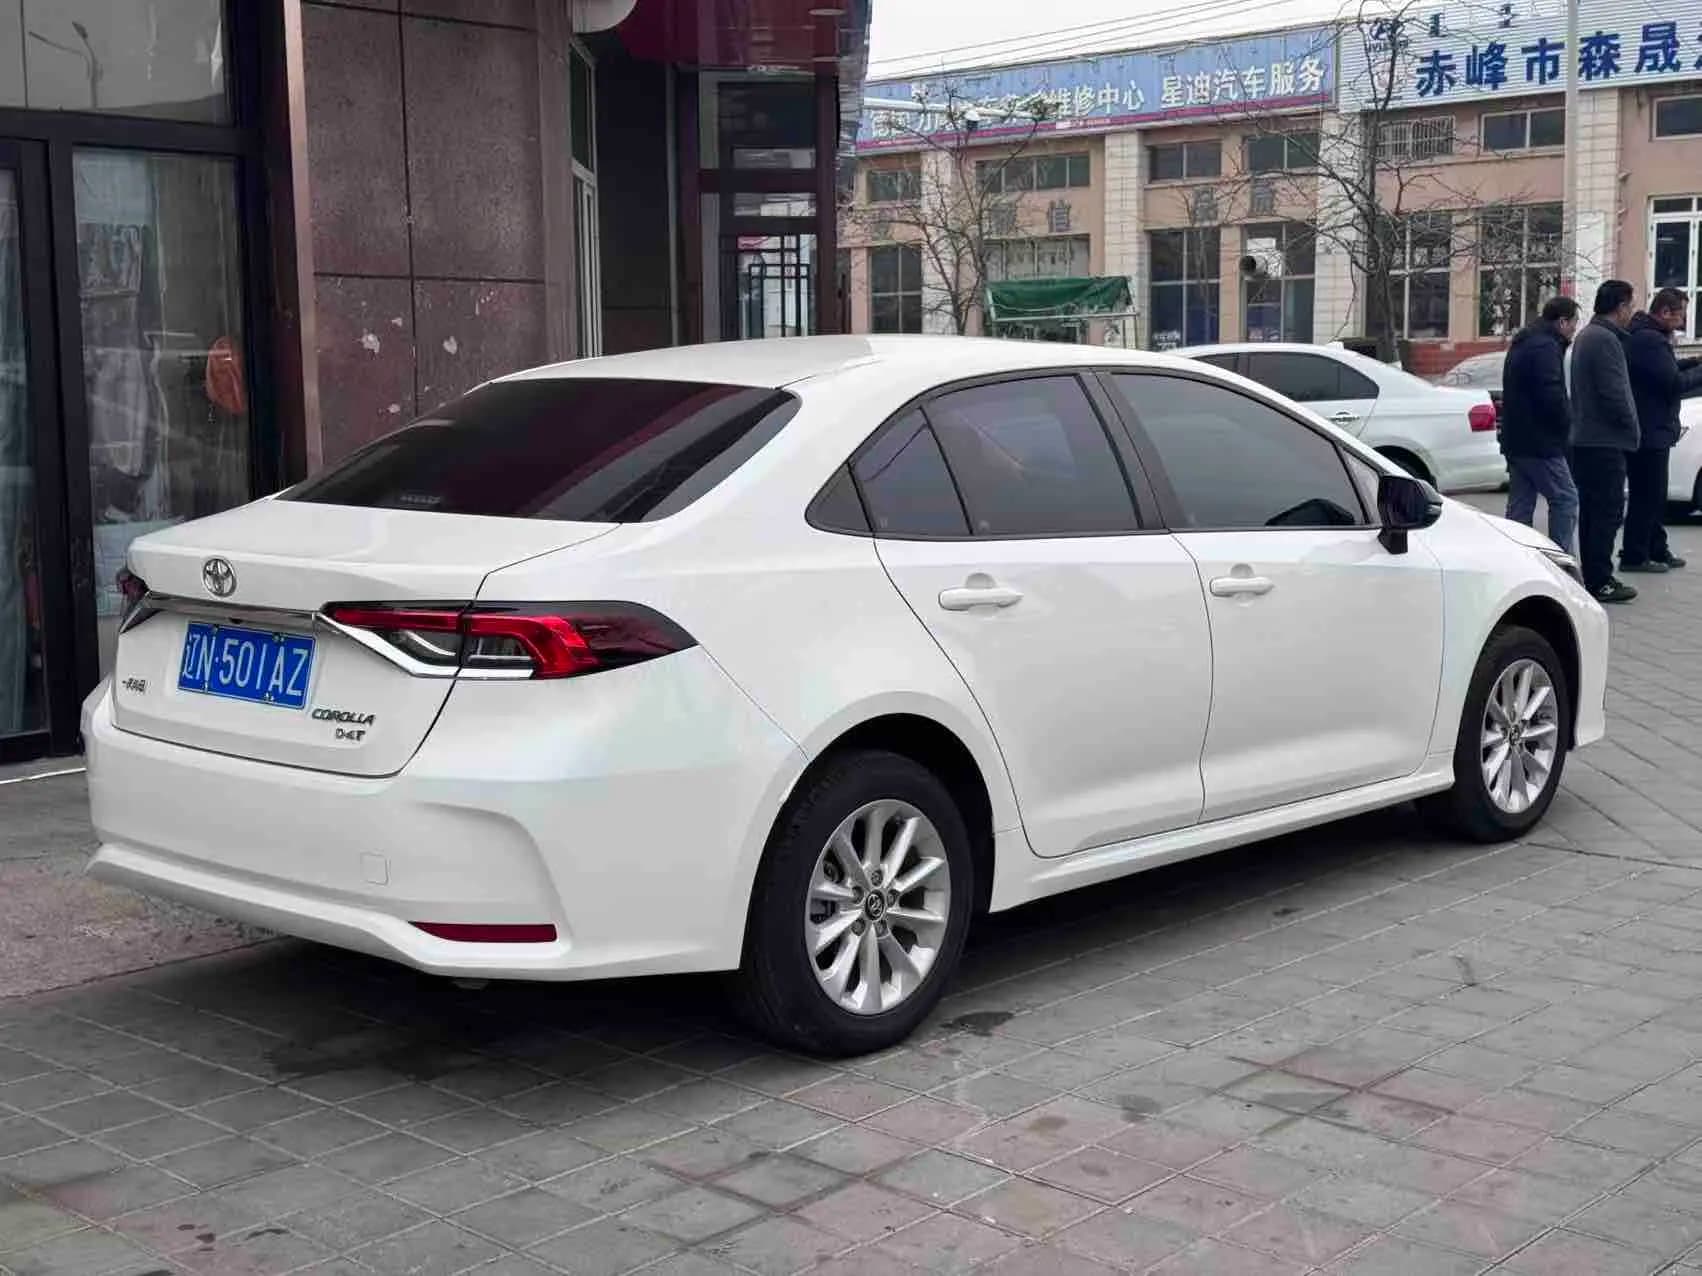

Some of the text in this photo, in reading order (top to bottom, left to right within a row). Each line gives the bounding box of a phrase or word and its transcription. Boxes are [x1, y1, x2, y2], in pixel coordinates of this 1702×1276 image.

[1160, 55, 1325, 109] 星迪汽车服务
[1415, 21, 1702, 97] 赤峰市森晟
[312, 708, 376, 727] COROLLA
